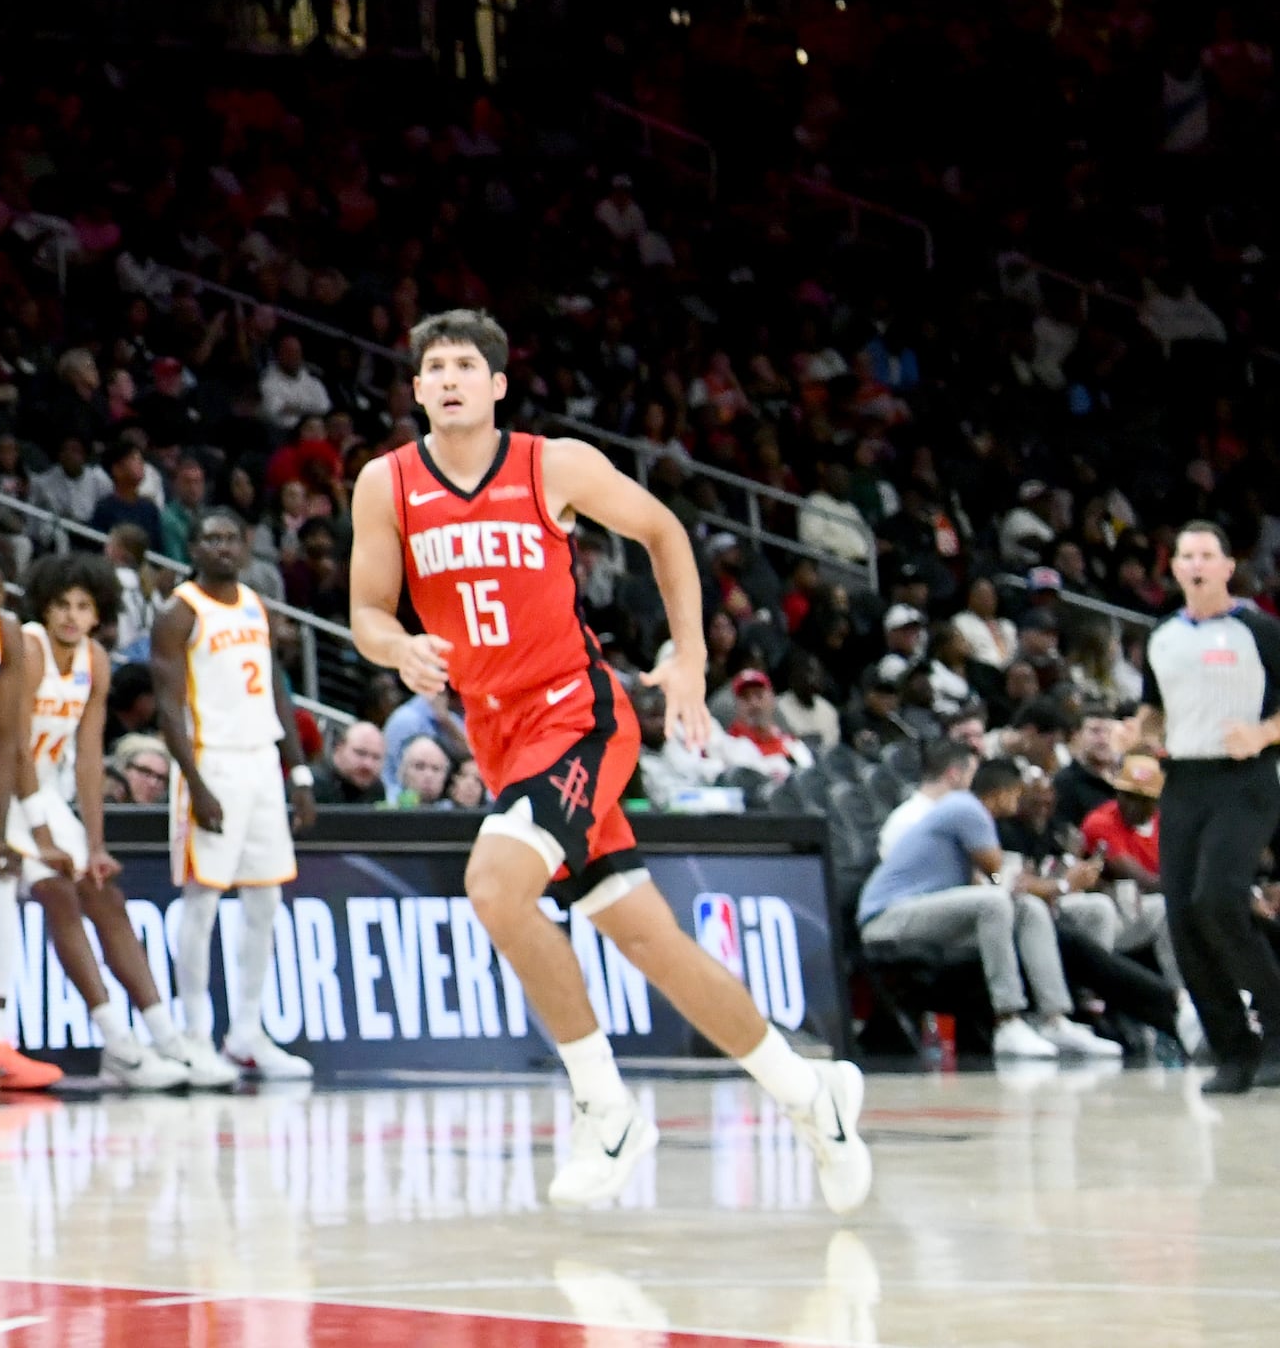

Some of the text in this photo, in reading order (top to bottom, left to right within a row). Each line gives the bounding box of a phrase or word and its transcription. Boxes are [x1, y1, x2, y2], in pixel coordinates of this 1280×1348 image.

[410, 520, 544, 577] ROCKETS
[456, 579, 509, 647] 15
[241, 658, 265, 696] 2
